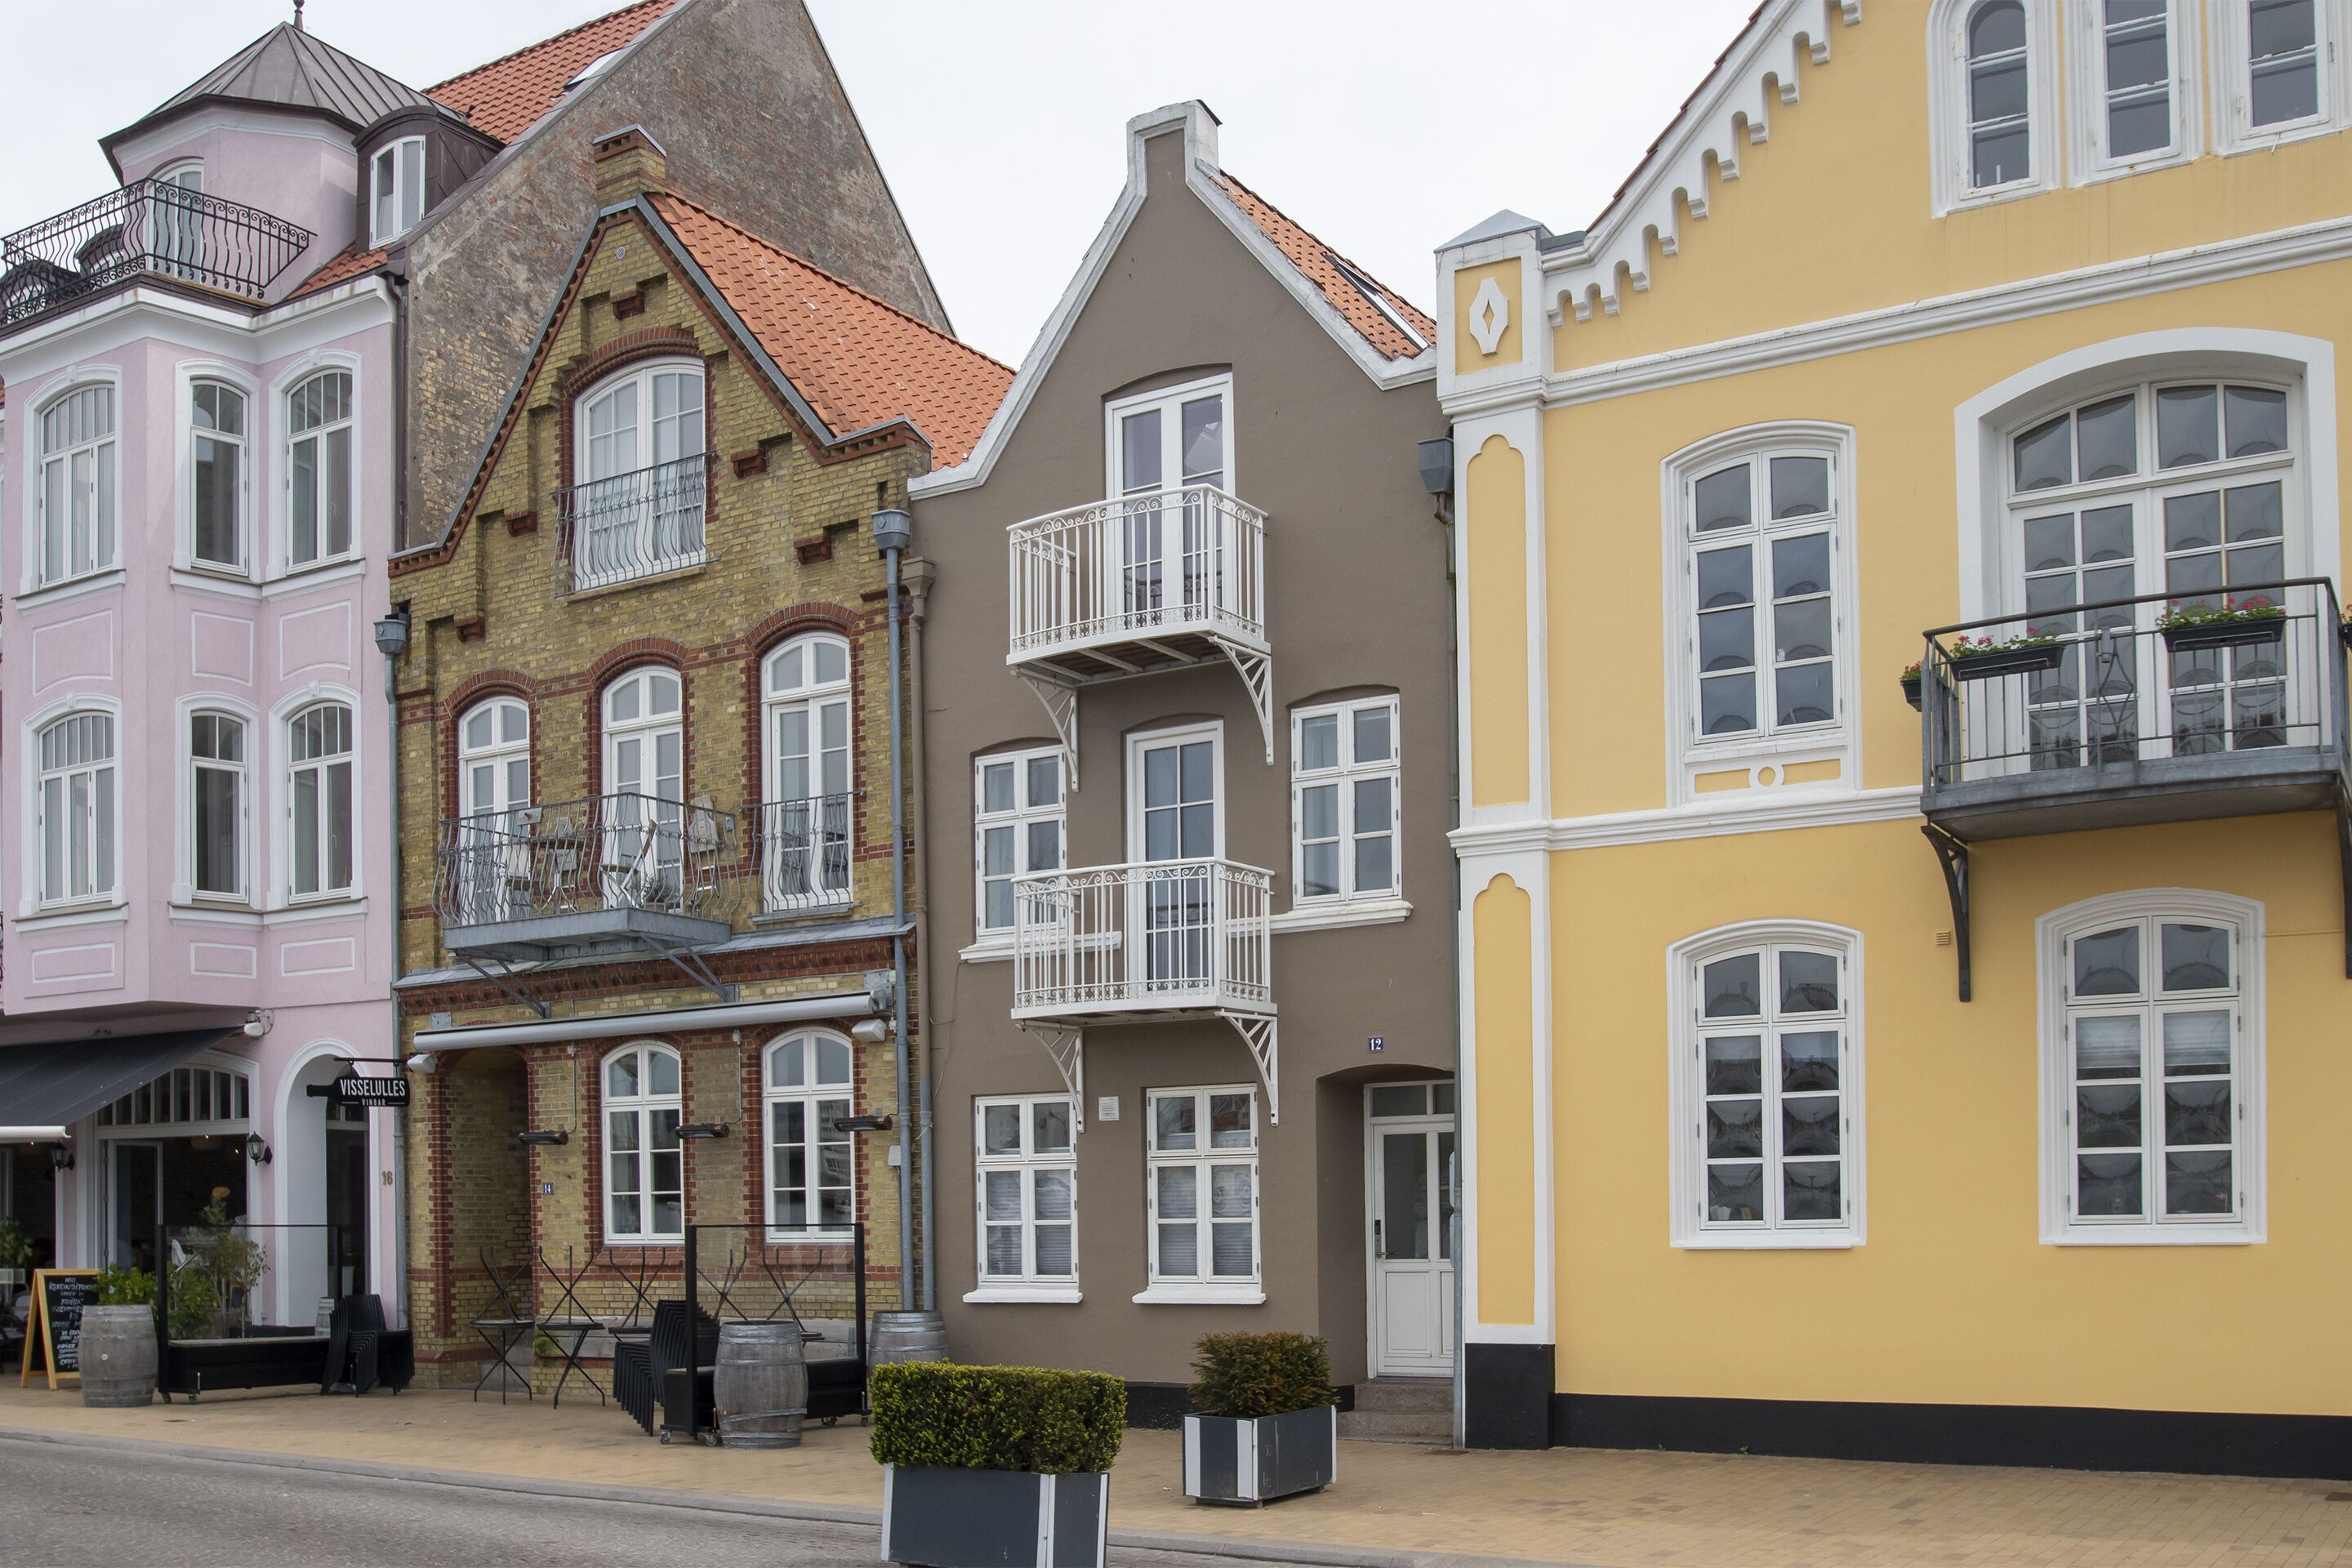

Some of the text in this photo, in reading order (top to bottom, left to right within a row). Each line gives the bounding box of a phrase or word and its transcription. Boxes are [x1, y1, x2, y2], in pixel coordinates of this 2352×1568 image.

[1370, 1038, 1382, 1051] 12
[340, 1079, 406, 1096] VISSELULLES
[362, 1098, 386, 1107] VINBAR
[381, 1170, 393, 1185] 16
[545, 1183, 551, 1193] 14
